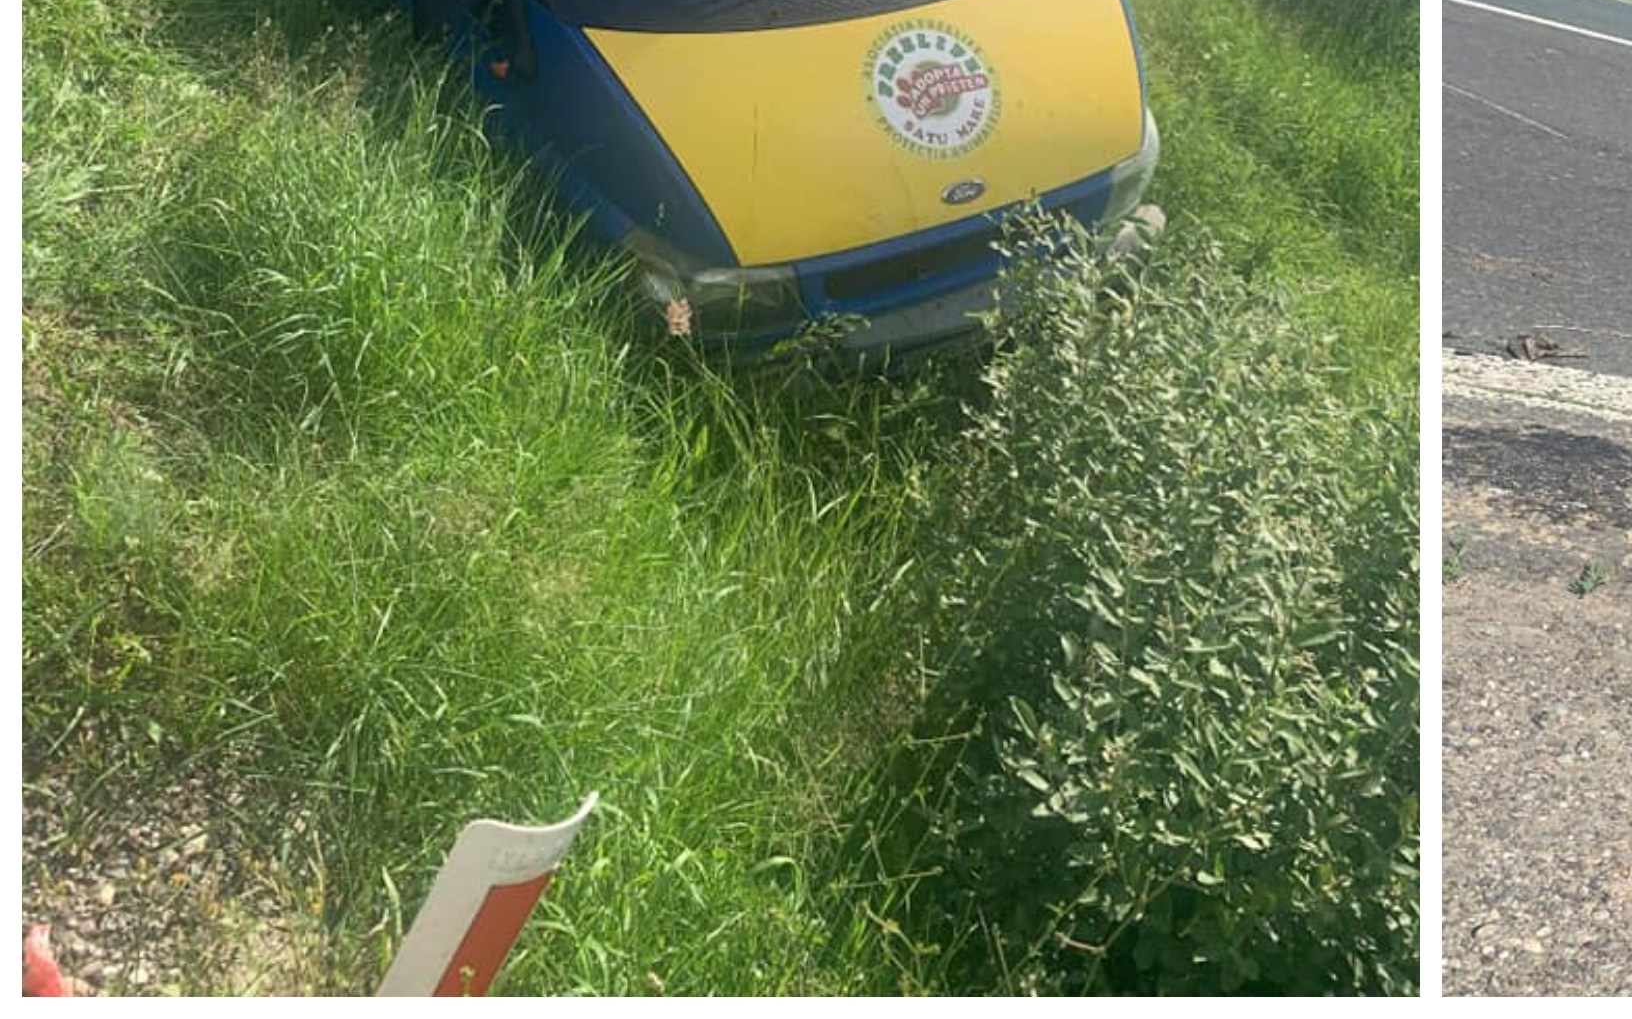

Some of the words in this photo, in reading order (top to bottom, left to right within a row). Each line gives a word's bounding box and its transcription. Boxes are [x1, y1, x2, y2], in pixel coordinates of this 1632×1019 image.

[910, 66, 964, 101] ADOPTA
[903, 119, 948, 146] SATU
[955, 98, 986, 139] MARE
